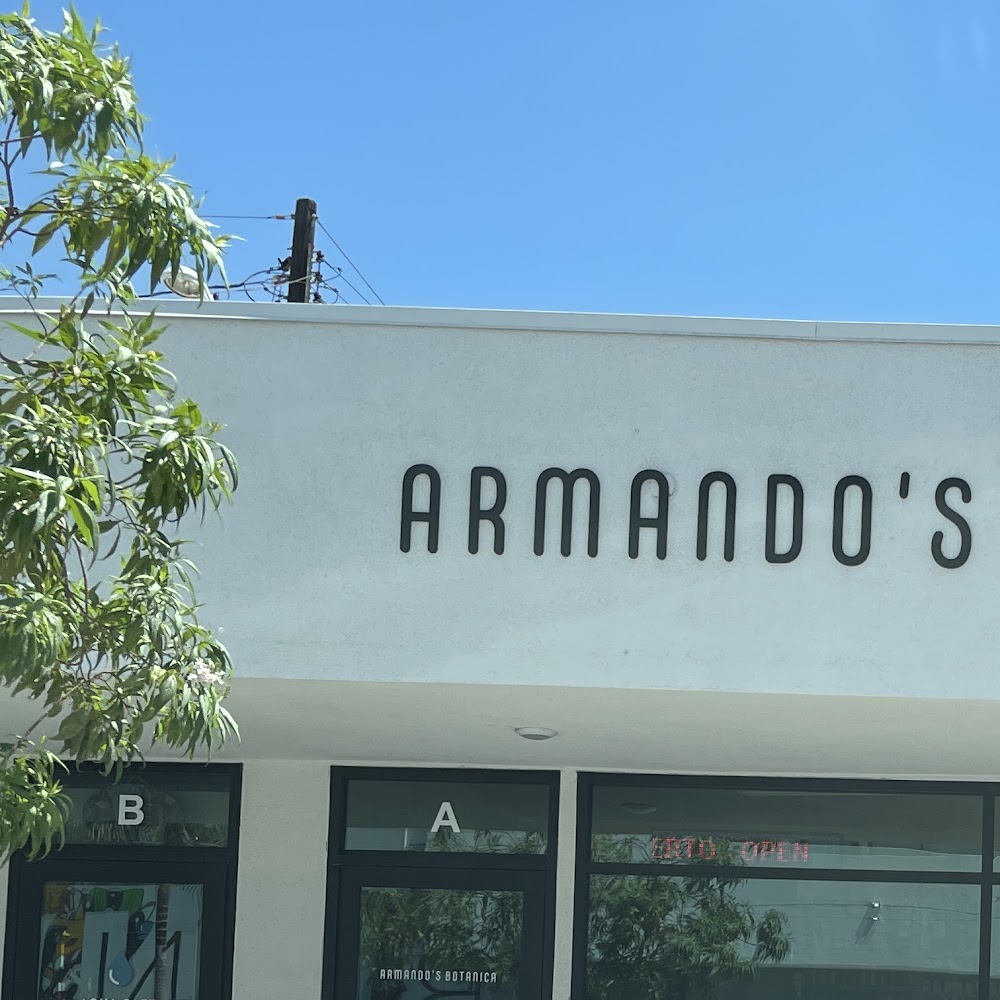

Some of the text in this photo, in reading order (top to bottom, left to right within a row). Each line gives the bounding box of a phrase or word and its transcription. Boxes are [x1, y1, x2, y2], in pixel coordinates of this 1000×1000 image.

[399, 463, 973, 570] ARMANDO'S
[118, 794, 145, 826] B
[430, 801, 461, 833] A
[740, 840, 809, 863] OPEN
[379, 968, 498, 984] ARMANDO'S BOTANICA
